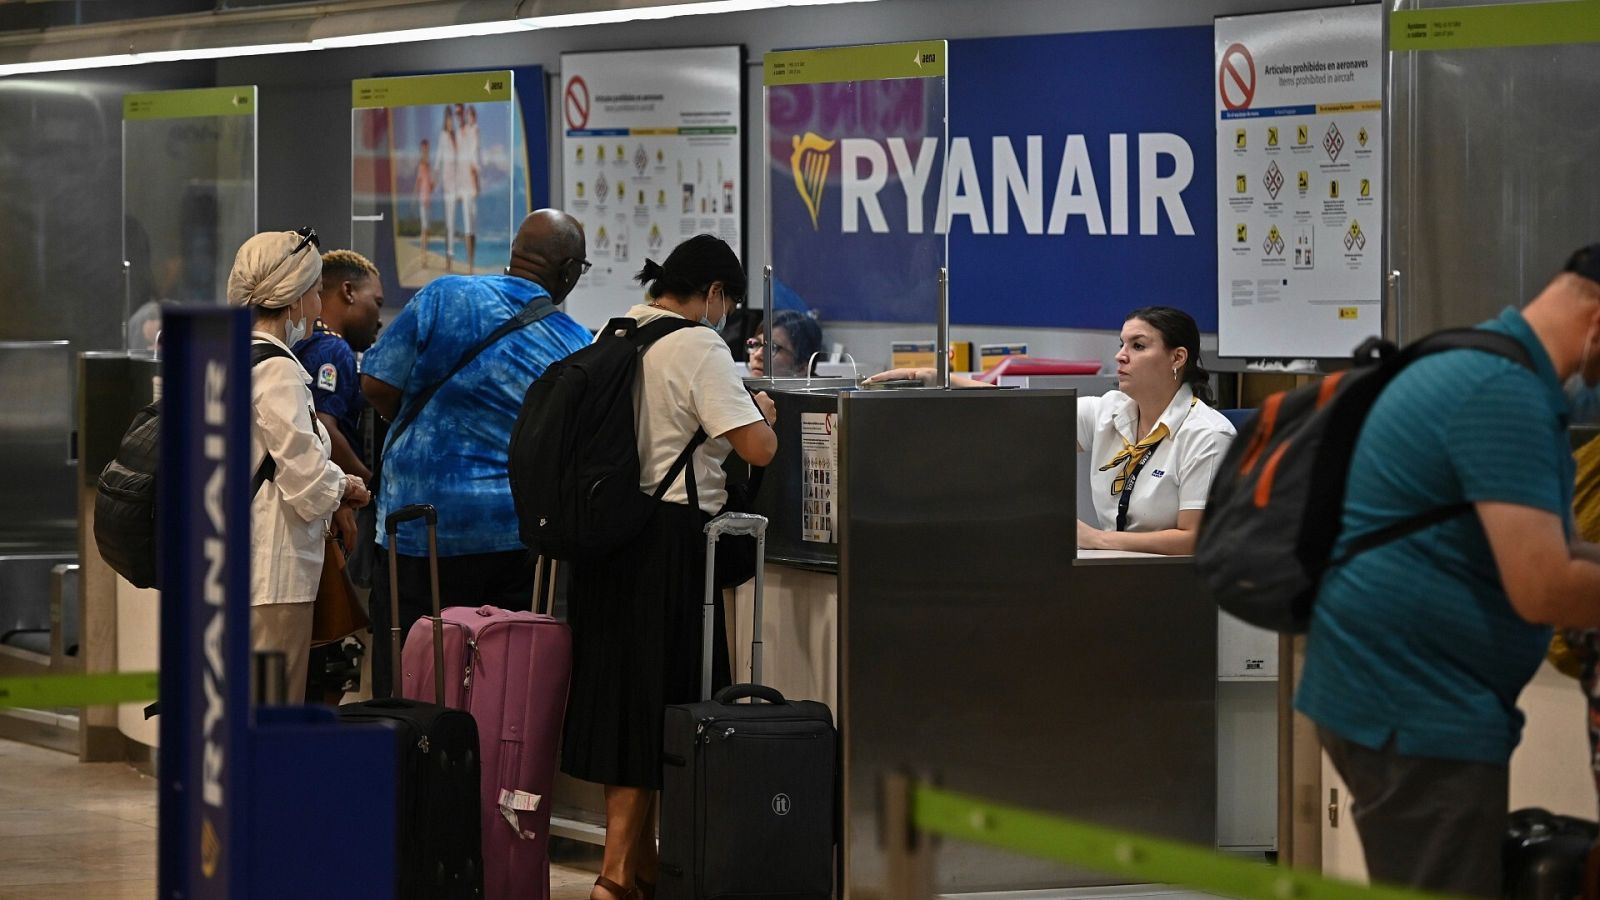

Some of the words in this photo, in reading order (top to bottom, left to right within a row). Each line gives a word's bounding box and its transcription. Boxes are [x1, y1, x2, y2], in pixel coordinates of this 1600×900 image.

[922, 53, 936, 64] aena
[1293, 61, 1326, 75] prohibidos
[1327, 62, 1336, 70] en
[1336, 60, 1368, 70] aeronaves
[1279, 77, 1295, 86] Items
[1295, 73, 1326, 87] prohibited
[1327, 74, 1333, 83] in
[1333, 70, 1354, 83] aircraft
[840, 133, 1196, 236] RYANAIR
[1126, 475, 1136, 491] AZUL
[203, 358, 226, 808] RYANAIR
[776, 796, 787, 812] it
